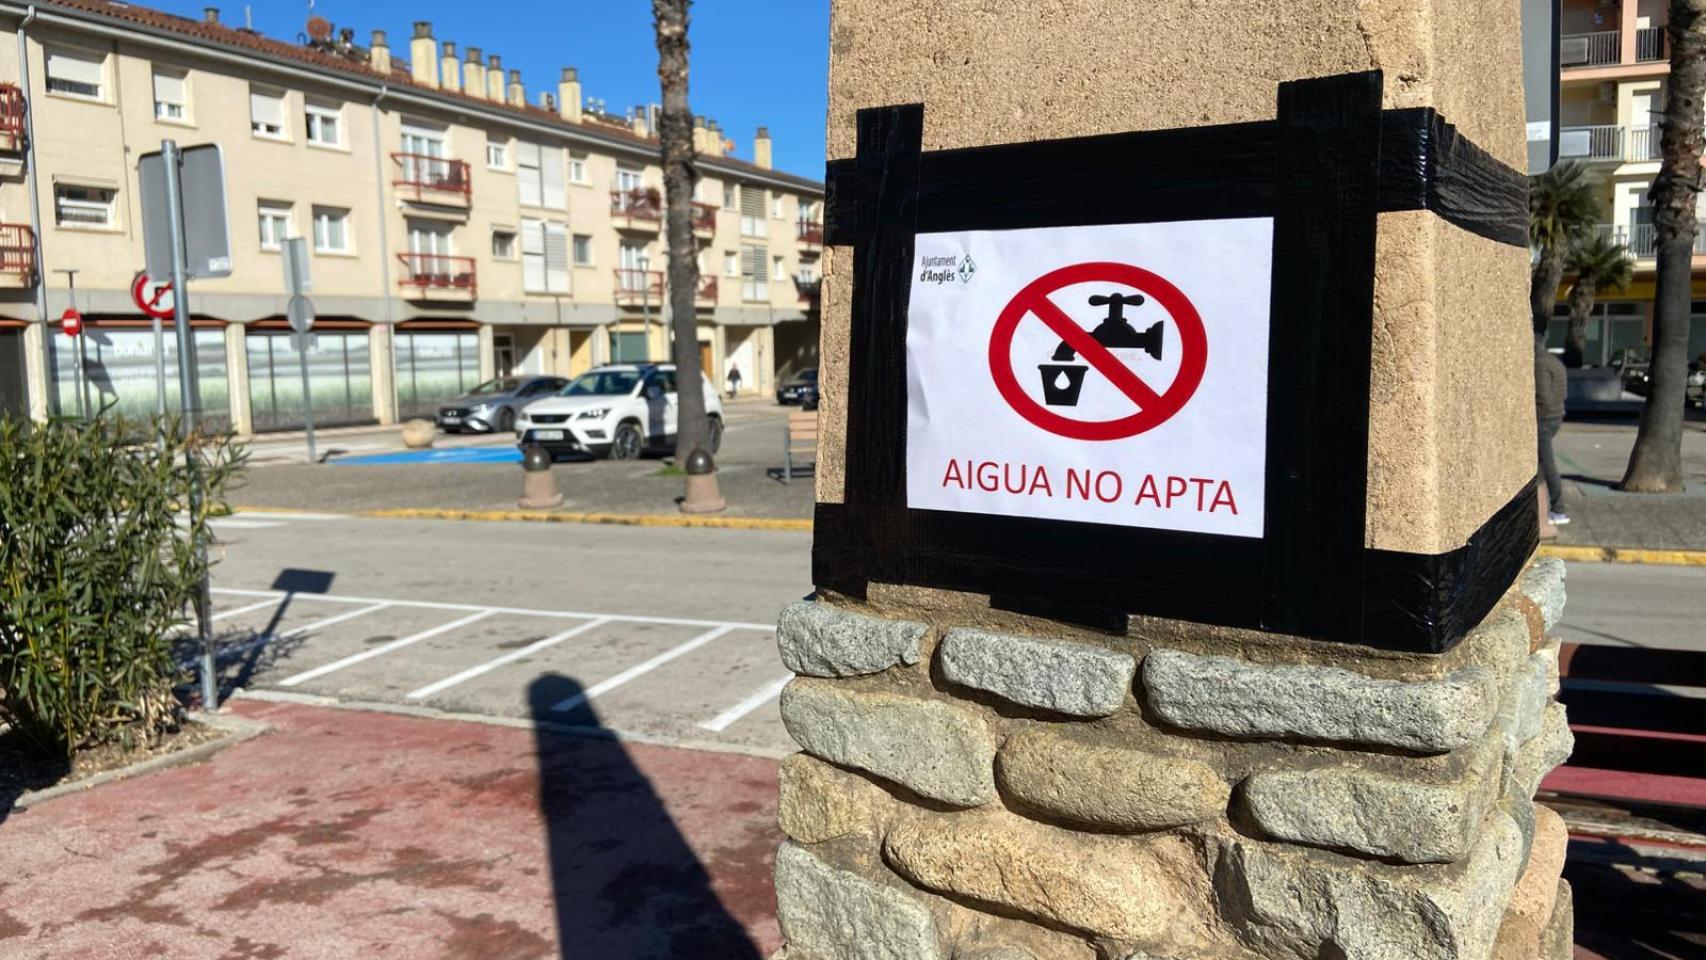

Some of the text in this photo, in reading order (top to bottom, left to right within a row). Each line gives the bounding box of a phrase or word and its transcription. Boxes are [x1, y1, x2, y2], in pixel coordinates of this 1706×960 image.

[921, 255, 956, 270] Ajuntament
[920, 269, 956, 285] d'Anglès
[943, 458, 1238, 515] AIGUA NO APTA
